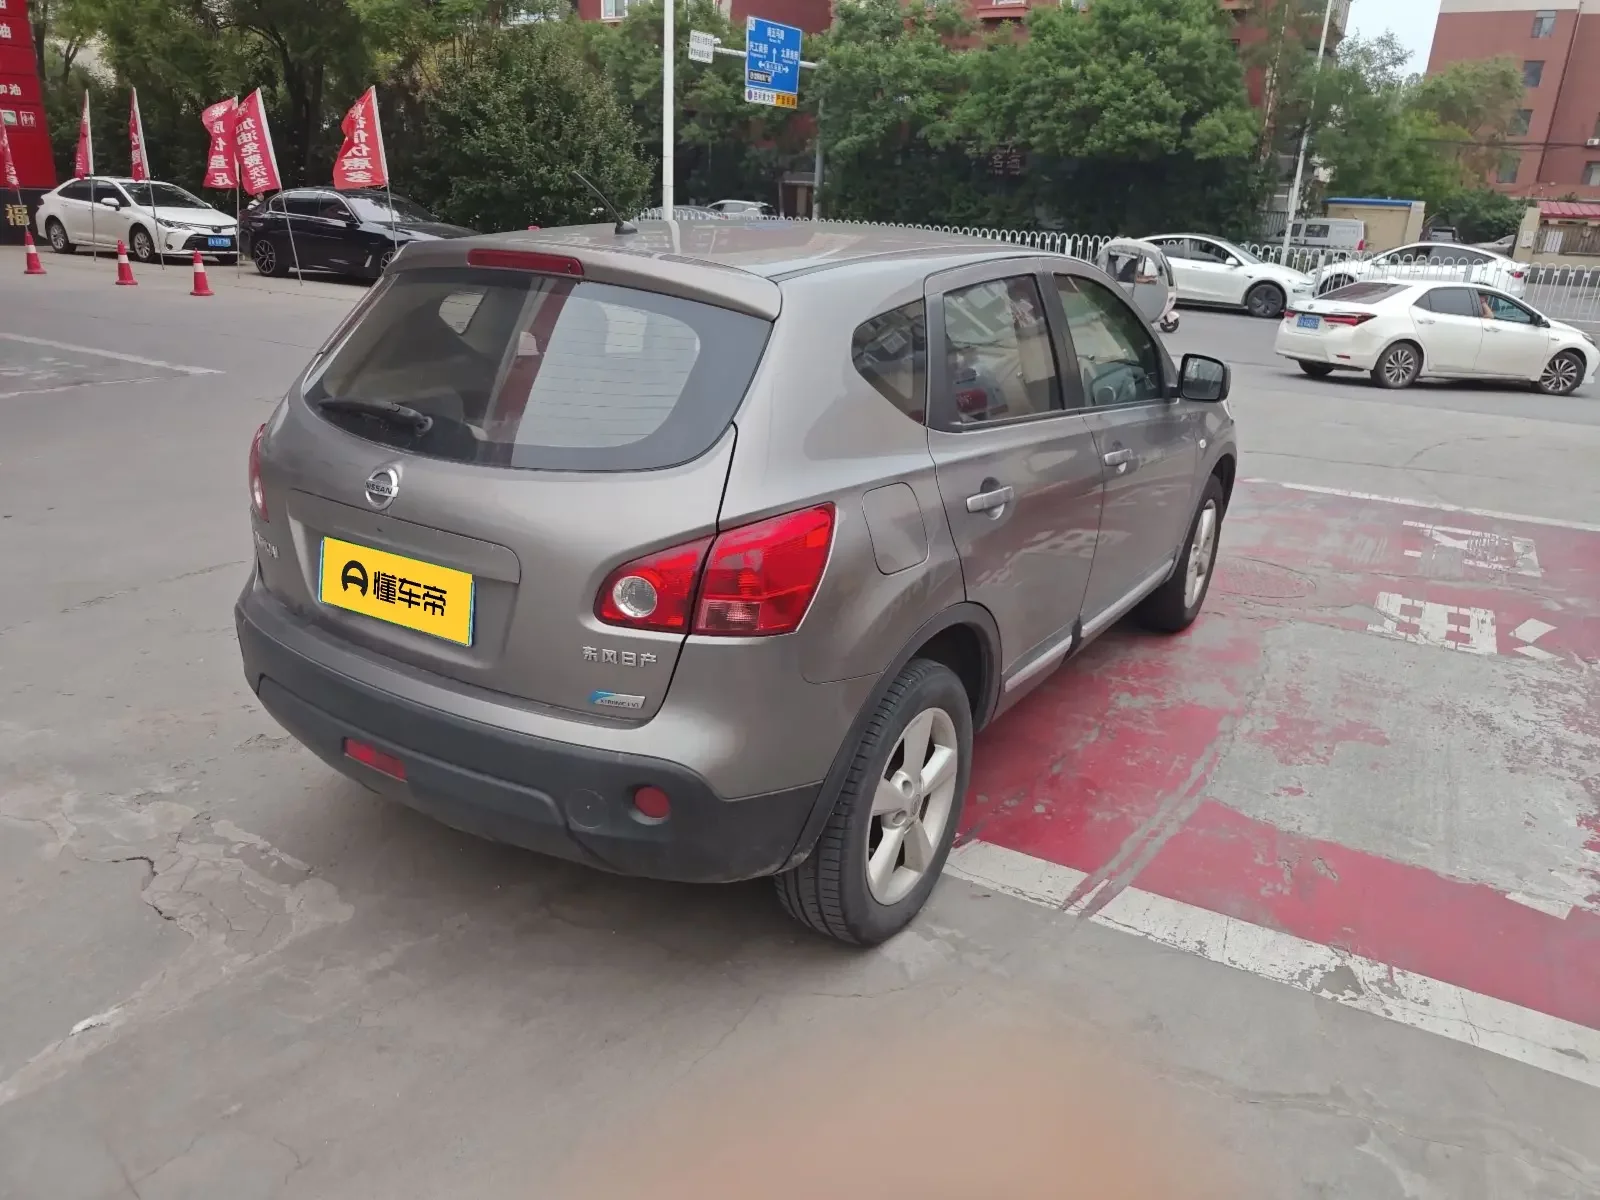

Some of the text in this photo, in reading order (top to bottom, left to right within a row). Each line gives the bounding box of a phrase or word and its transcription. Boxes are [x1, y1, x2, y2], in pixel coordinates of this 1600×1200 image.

[5, 204, 30, 226] 福
[364, 480, 393, 495] NISSAN
[582, 645, 657, 668] 东风日产
